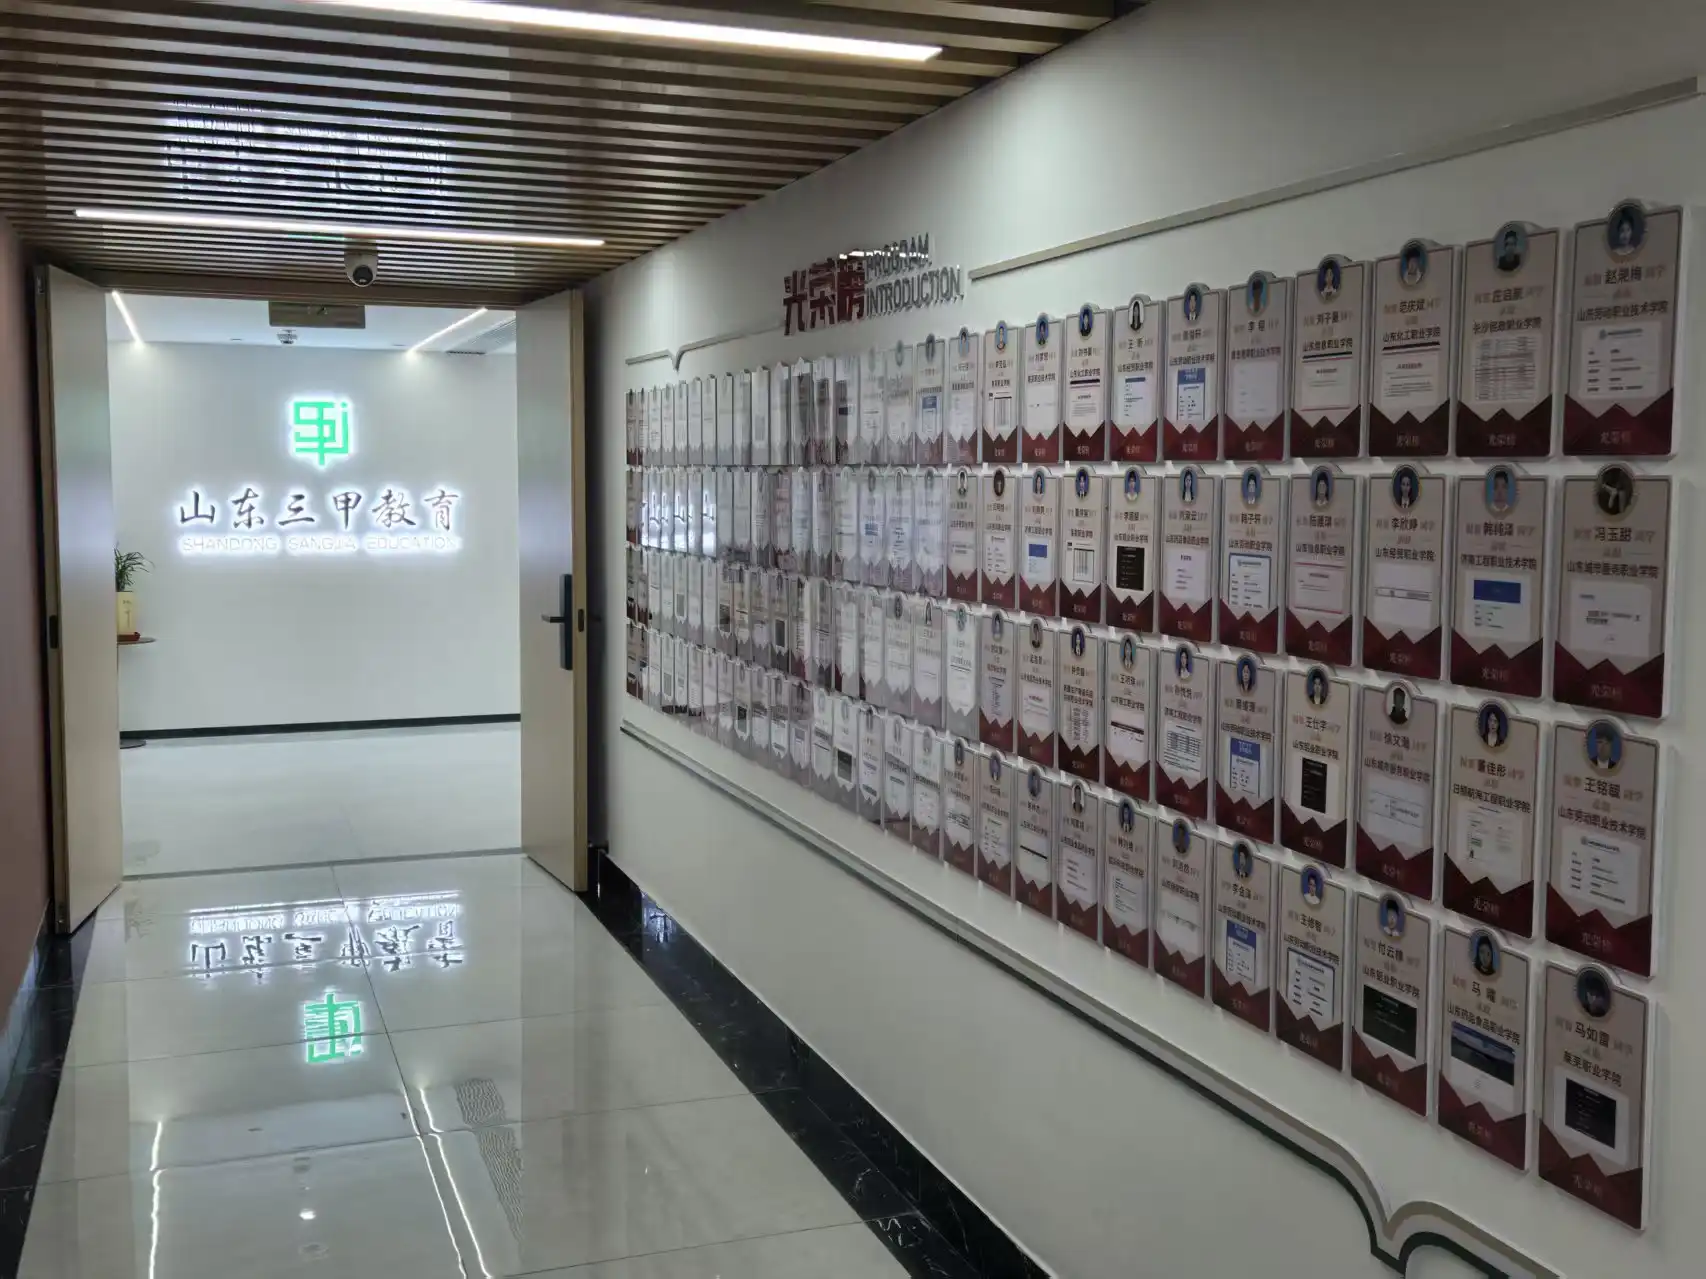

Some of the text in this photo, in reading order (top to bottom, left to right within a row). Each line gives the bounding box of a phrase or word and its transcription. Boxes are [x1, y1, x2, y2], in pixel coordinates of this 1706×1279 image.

[866, 266, 962, 317] INTRODUCTION
[178, 487, 460, 532] 山东三甲教育
[182, 535, 278, 552] SHANDONG
[366, 534, 459, 552] EDUCATION
[1557, 804, 1647, 841] 山东劳动职业技术学院
